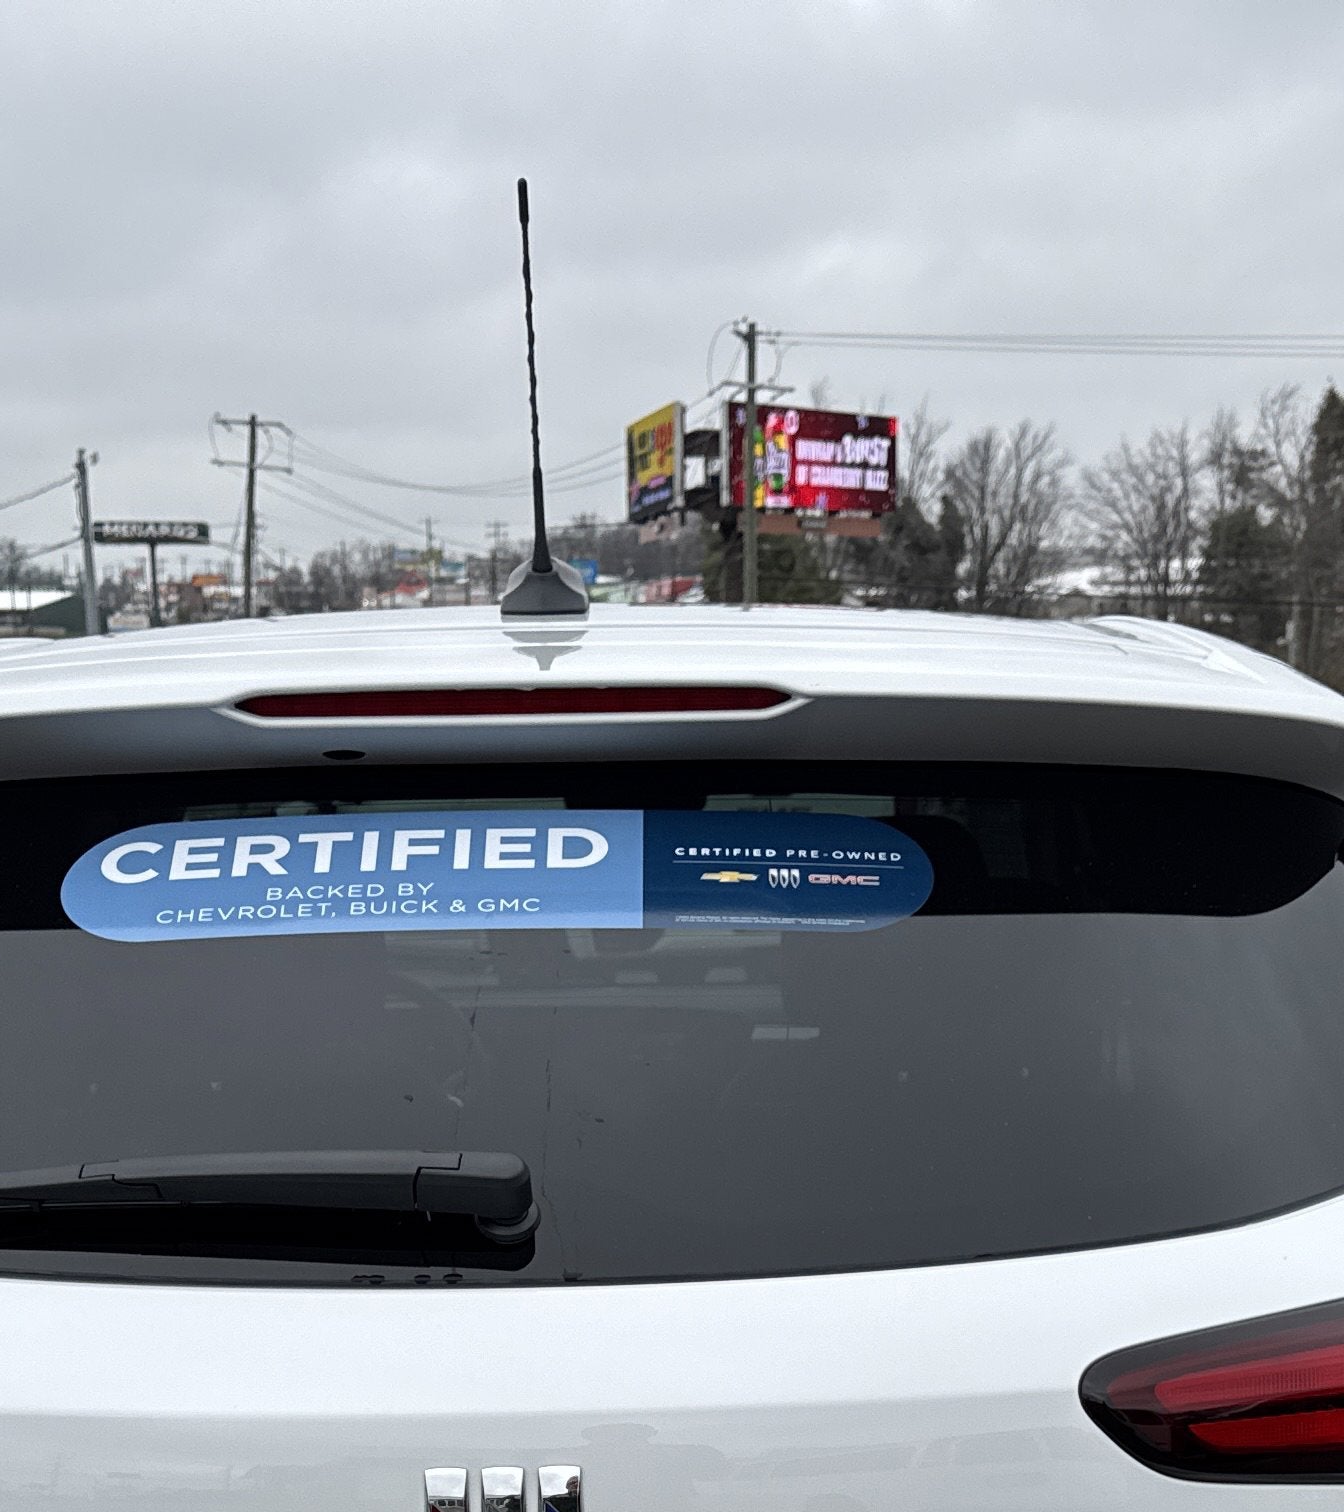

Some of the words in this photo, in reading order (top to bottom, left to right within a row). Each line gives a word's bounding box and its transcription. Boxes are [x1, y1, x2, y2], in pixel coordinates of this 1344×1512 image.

[100, 827, 610, 884] CERTIFIED
[674, 847, 777, 858] CERTIFIED
[786, 849, 902, 862] PRE-OWNED
[808, 873, 881, 887] GMC
[266, 882, 385, 901] BACKED
[397, 881, 434, 896] BY
[156, 902, 336, 924] CHEVROLET,
[349, 899, 439, 915] BUICK
[449, 899, 468, 913] &
[478, 897, 542, 913] GMC
